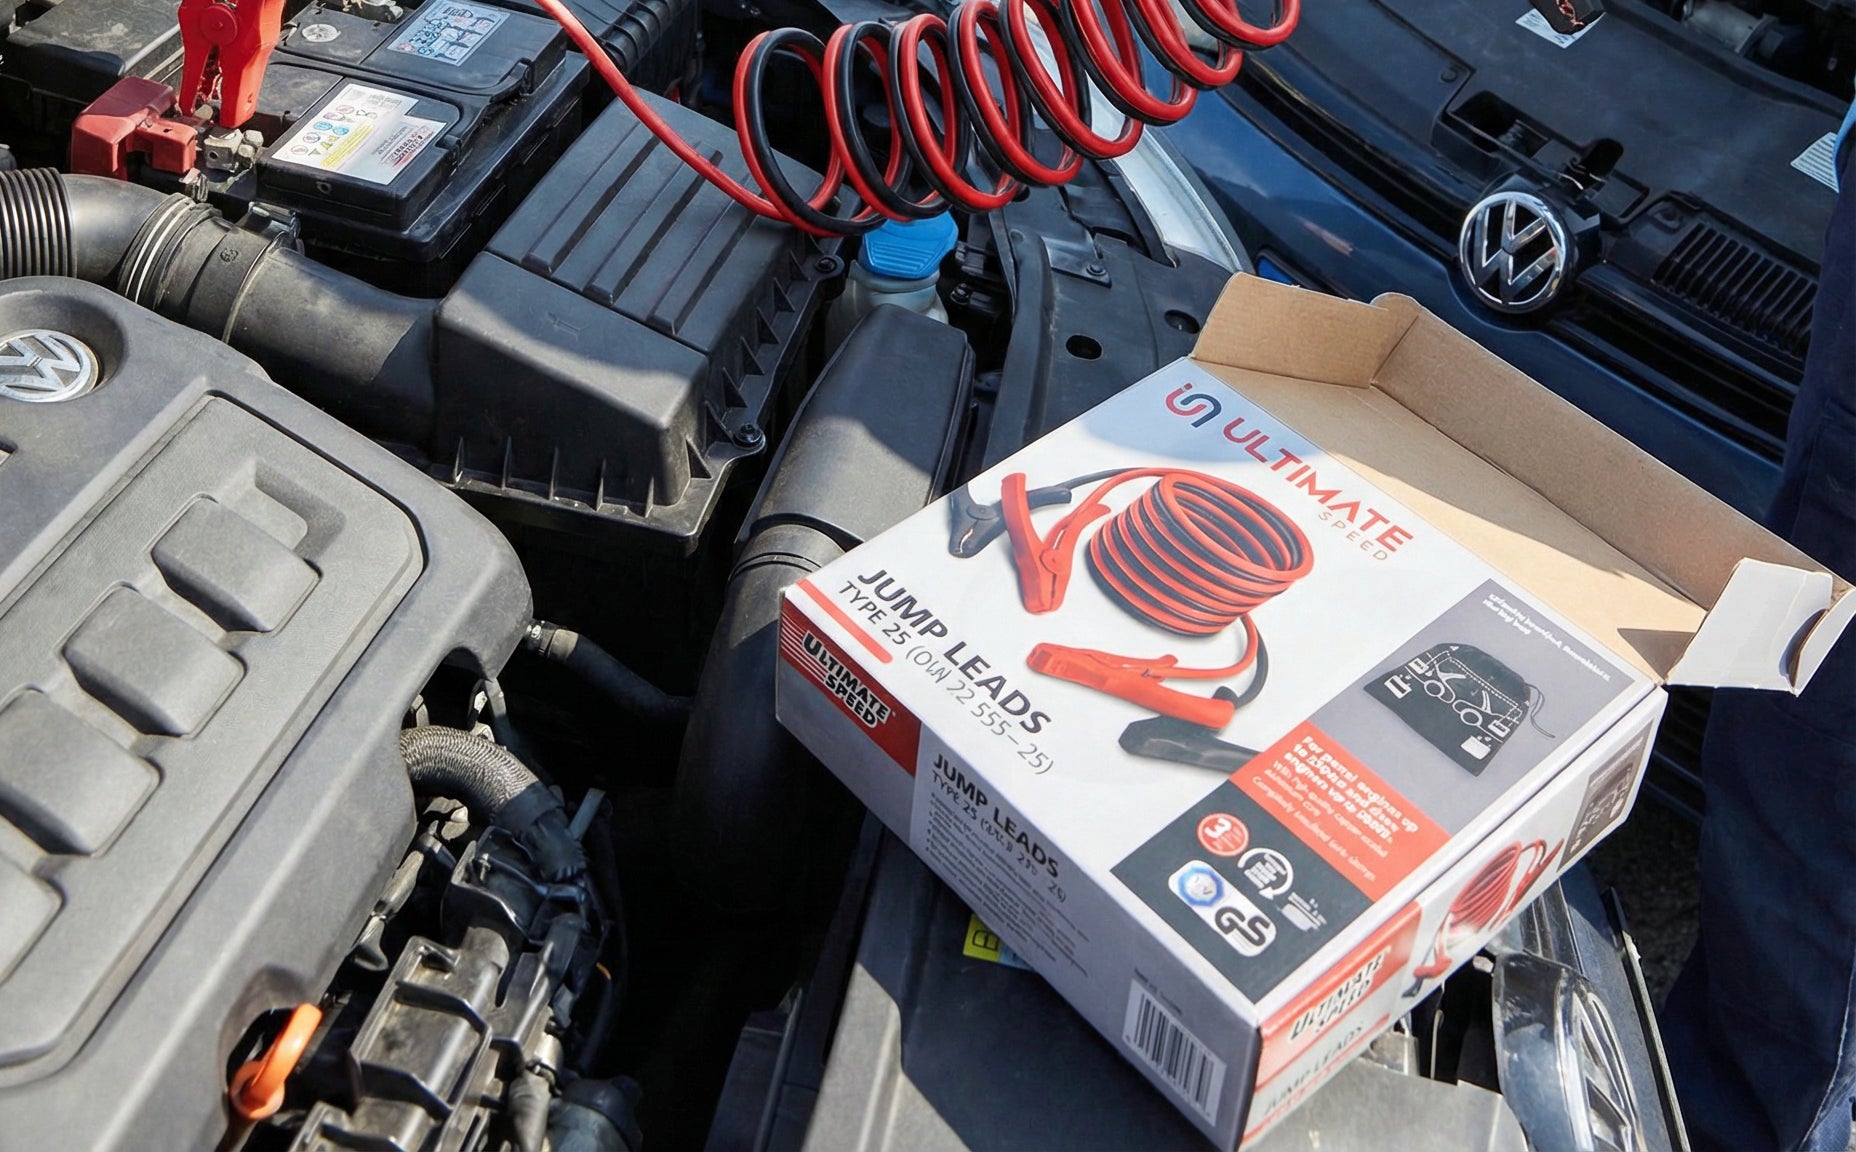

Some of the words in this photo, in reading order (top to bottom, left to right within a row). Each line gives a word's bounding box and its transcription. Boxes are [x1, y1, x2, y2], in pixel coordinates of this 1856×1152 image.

[1222, 415, 1414, 554] ULTIMATE
[1318, 509, 1388, 562] SPEED
[837, 579, 887, 625] TYPE
[881, 621, 912, 646] 25
[856, 568, 947, 636] JUMP
[942, 639, 1052, 734] LEADS
[802, 631, 889, 720] ULTIMATE
[824, 673, 877, 724] SPEED
[932, 752, 990, 808] JUMP
[992, 805, 1062, 876] LEADS
[1214, 904, 1270, 946] GS
